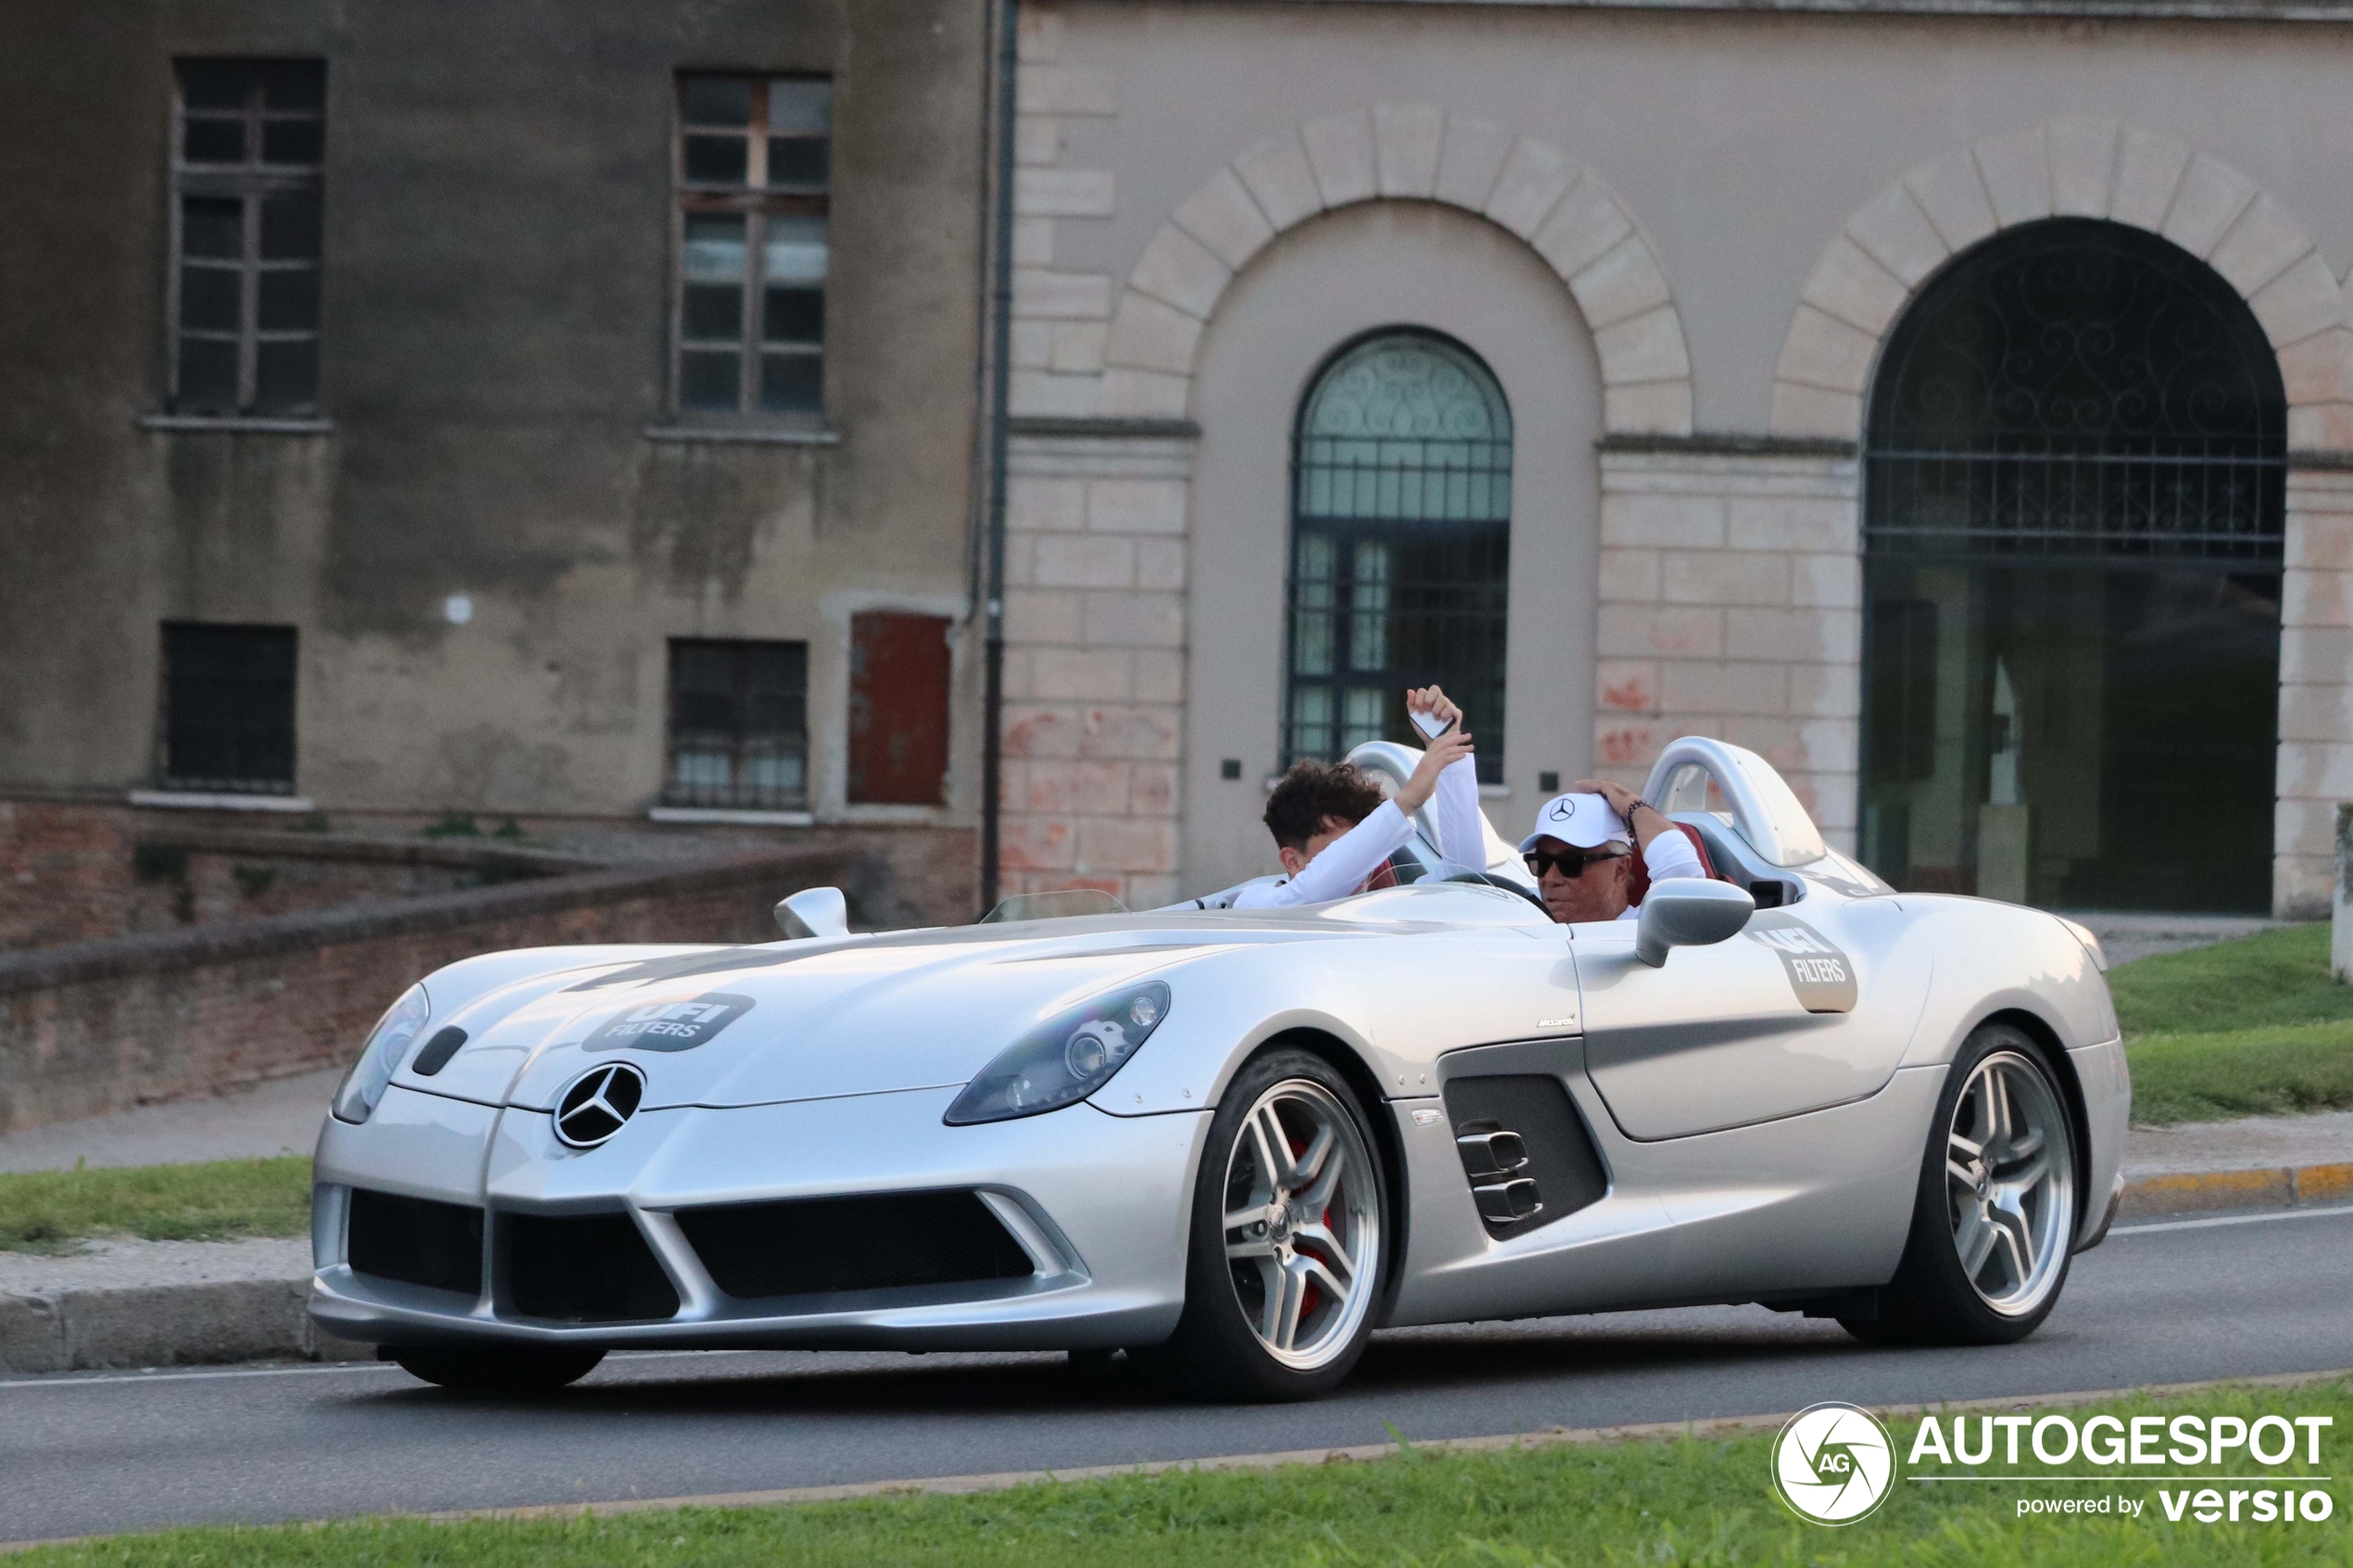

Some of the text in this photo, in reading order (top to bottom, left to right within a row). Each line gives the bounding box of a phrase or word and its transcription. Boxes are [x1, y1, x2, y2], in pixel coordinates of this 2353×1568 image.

[1791, 959, 1846, 983] FILTERS
[626, 1002, 731, 1023] UFI
[605, 1022, 701, 1037] FILTERS
